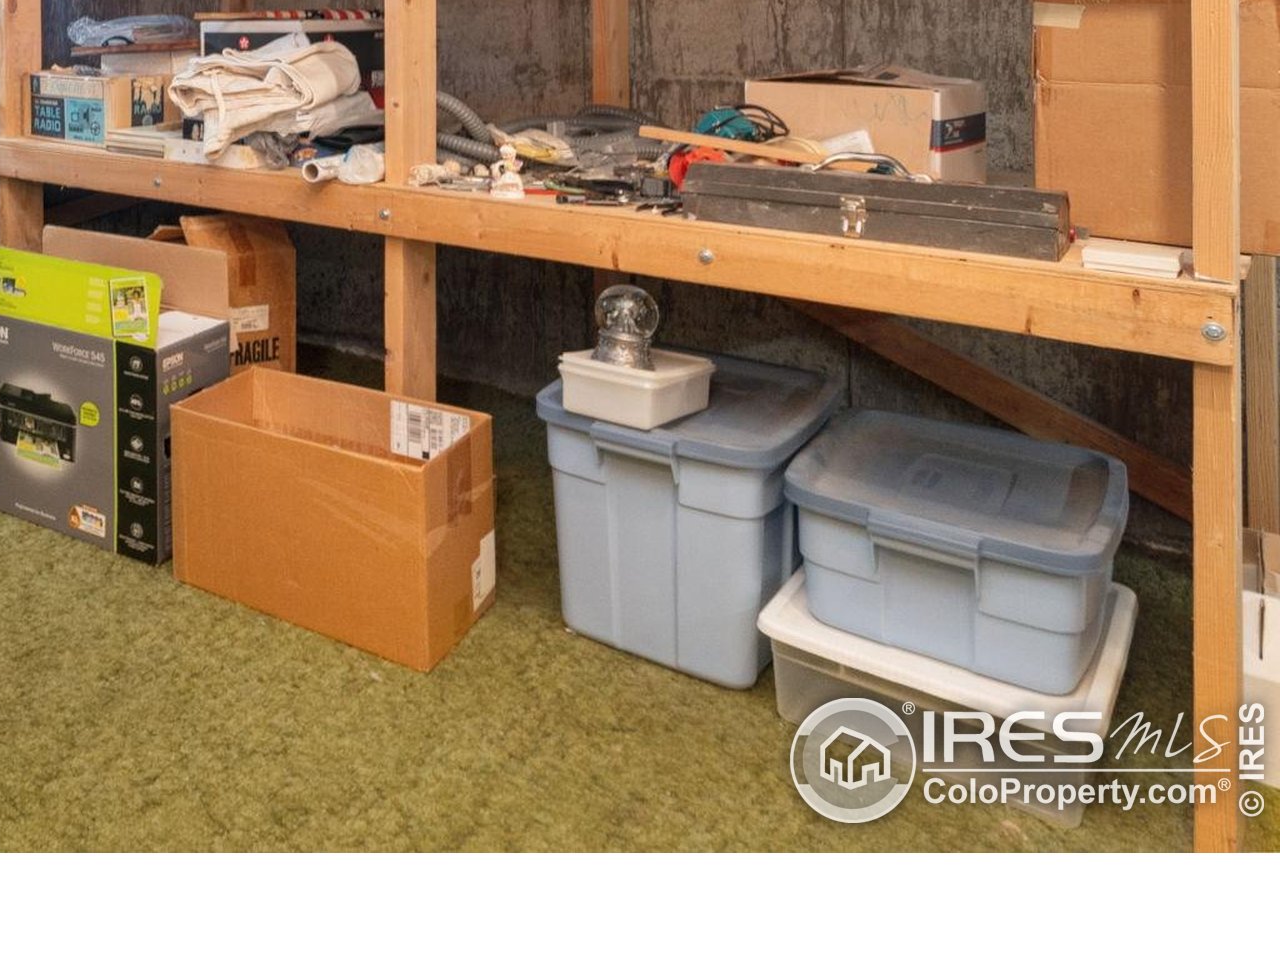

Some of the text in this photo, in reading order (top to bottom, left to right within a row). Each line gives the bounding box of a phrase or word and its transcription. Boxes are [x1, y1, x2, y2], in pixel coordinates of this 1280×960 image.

[34, 105, 61, 119] TABLE
[34, 117, 62, 133] RADIO
[90, 349, 106, 363] 545
